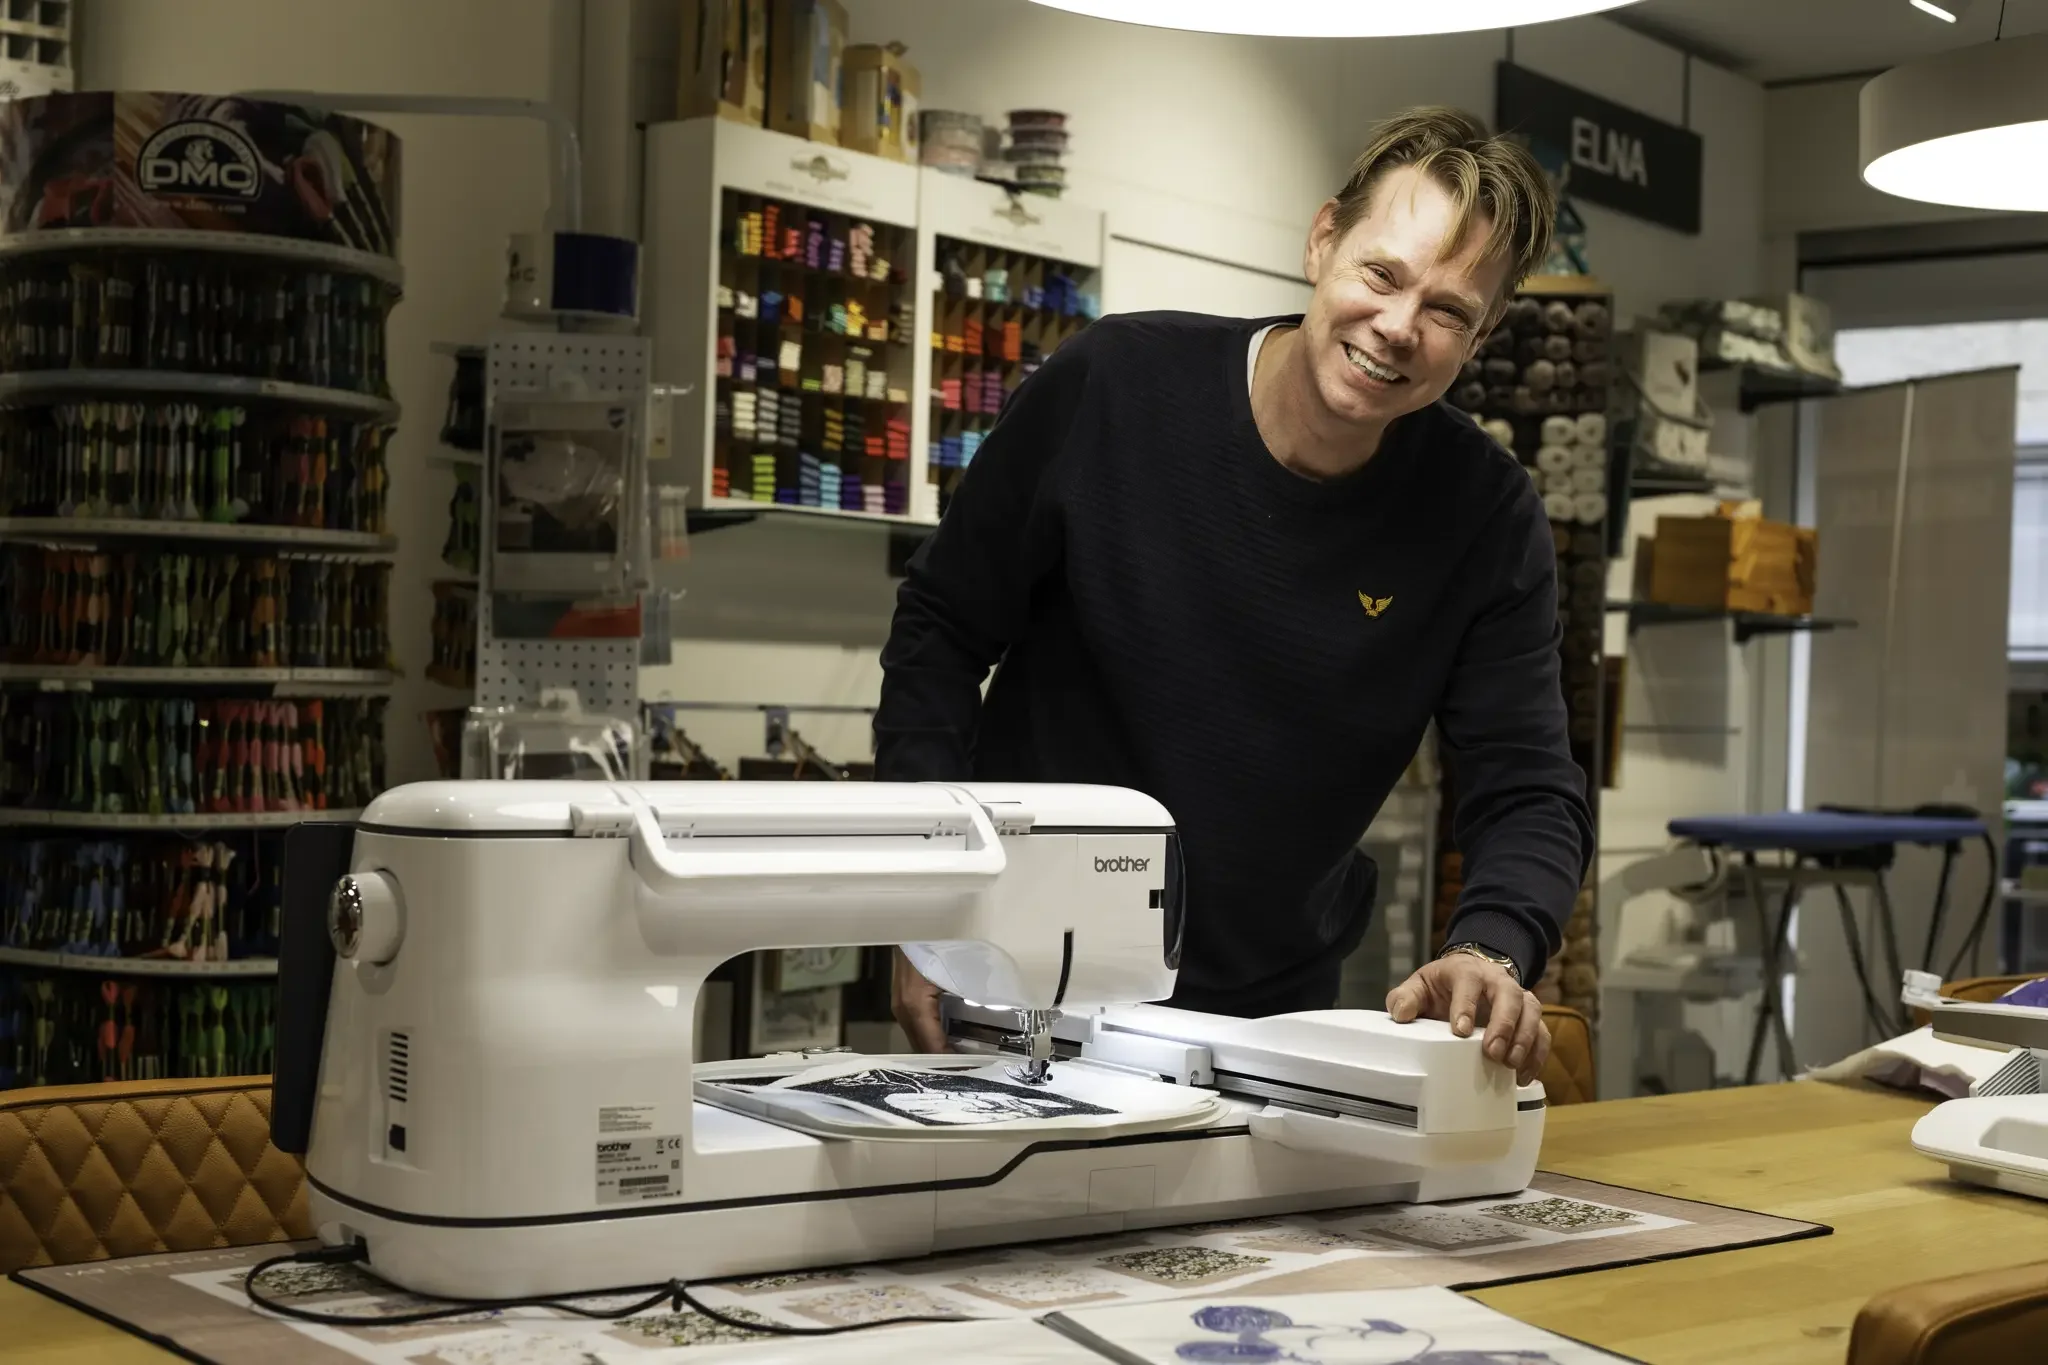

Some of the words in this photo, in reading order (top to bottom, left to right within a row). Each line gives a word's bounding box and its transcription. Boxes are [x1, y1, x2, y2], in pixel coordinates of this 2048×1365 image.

[1572, 117, 1647, 187] ELNA
[147, 159, 252, 189] DMC
[1095, 856, 1150, 872] brother
[597, 1142, 631, 1152] brother
